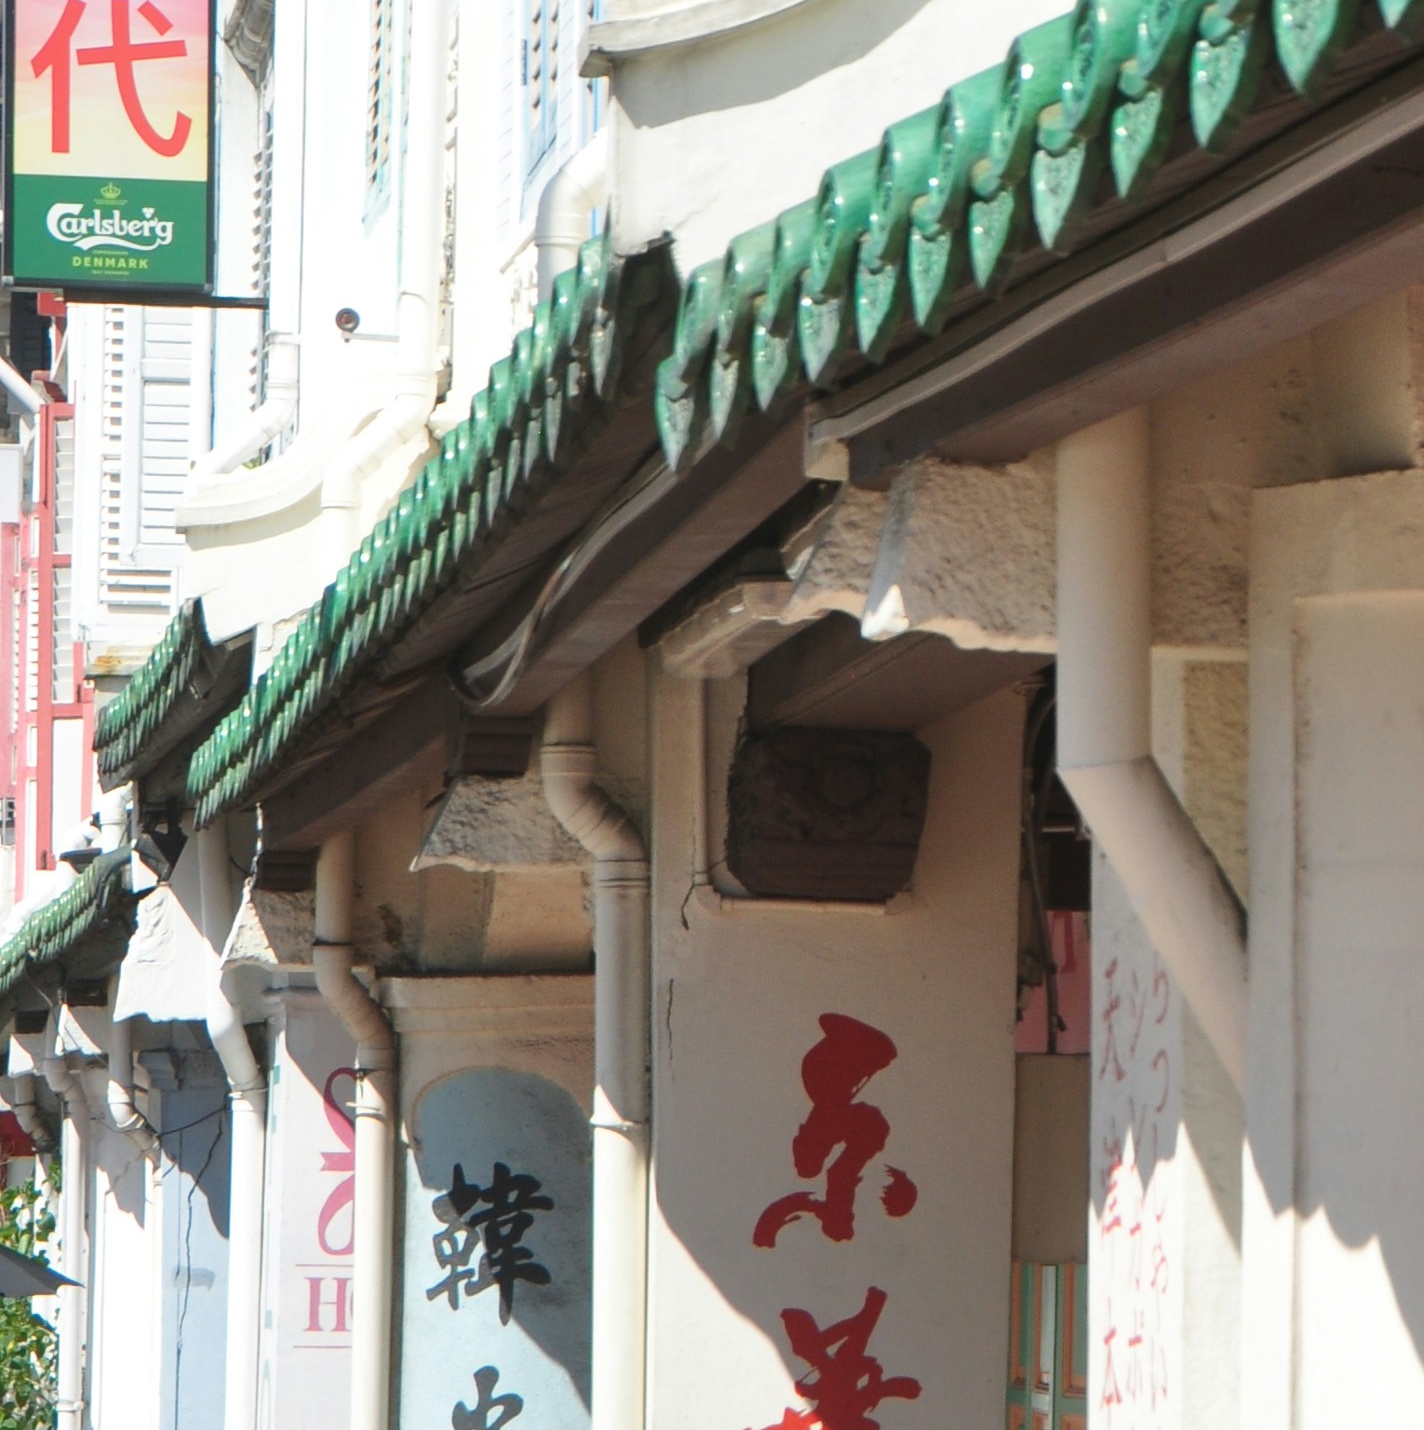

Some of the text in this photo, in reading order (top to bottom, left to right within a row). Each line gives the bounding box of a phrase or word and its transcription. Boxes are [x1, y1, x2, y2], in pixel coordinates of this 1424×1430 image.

[46, 201, 175, 251] Carlsberg
[72, 255, 149, 270] DENMARK
[303, 1276, 354, 1332] H
